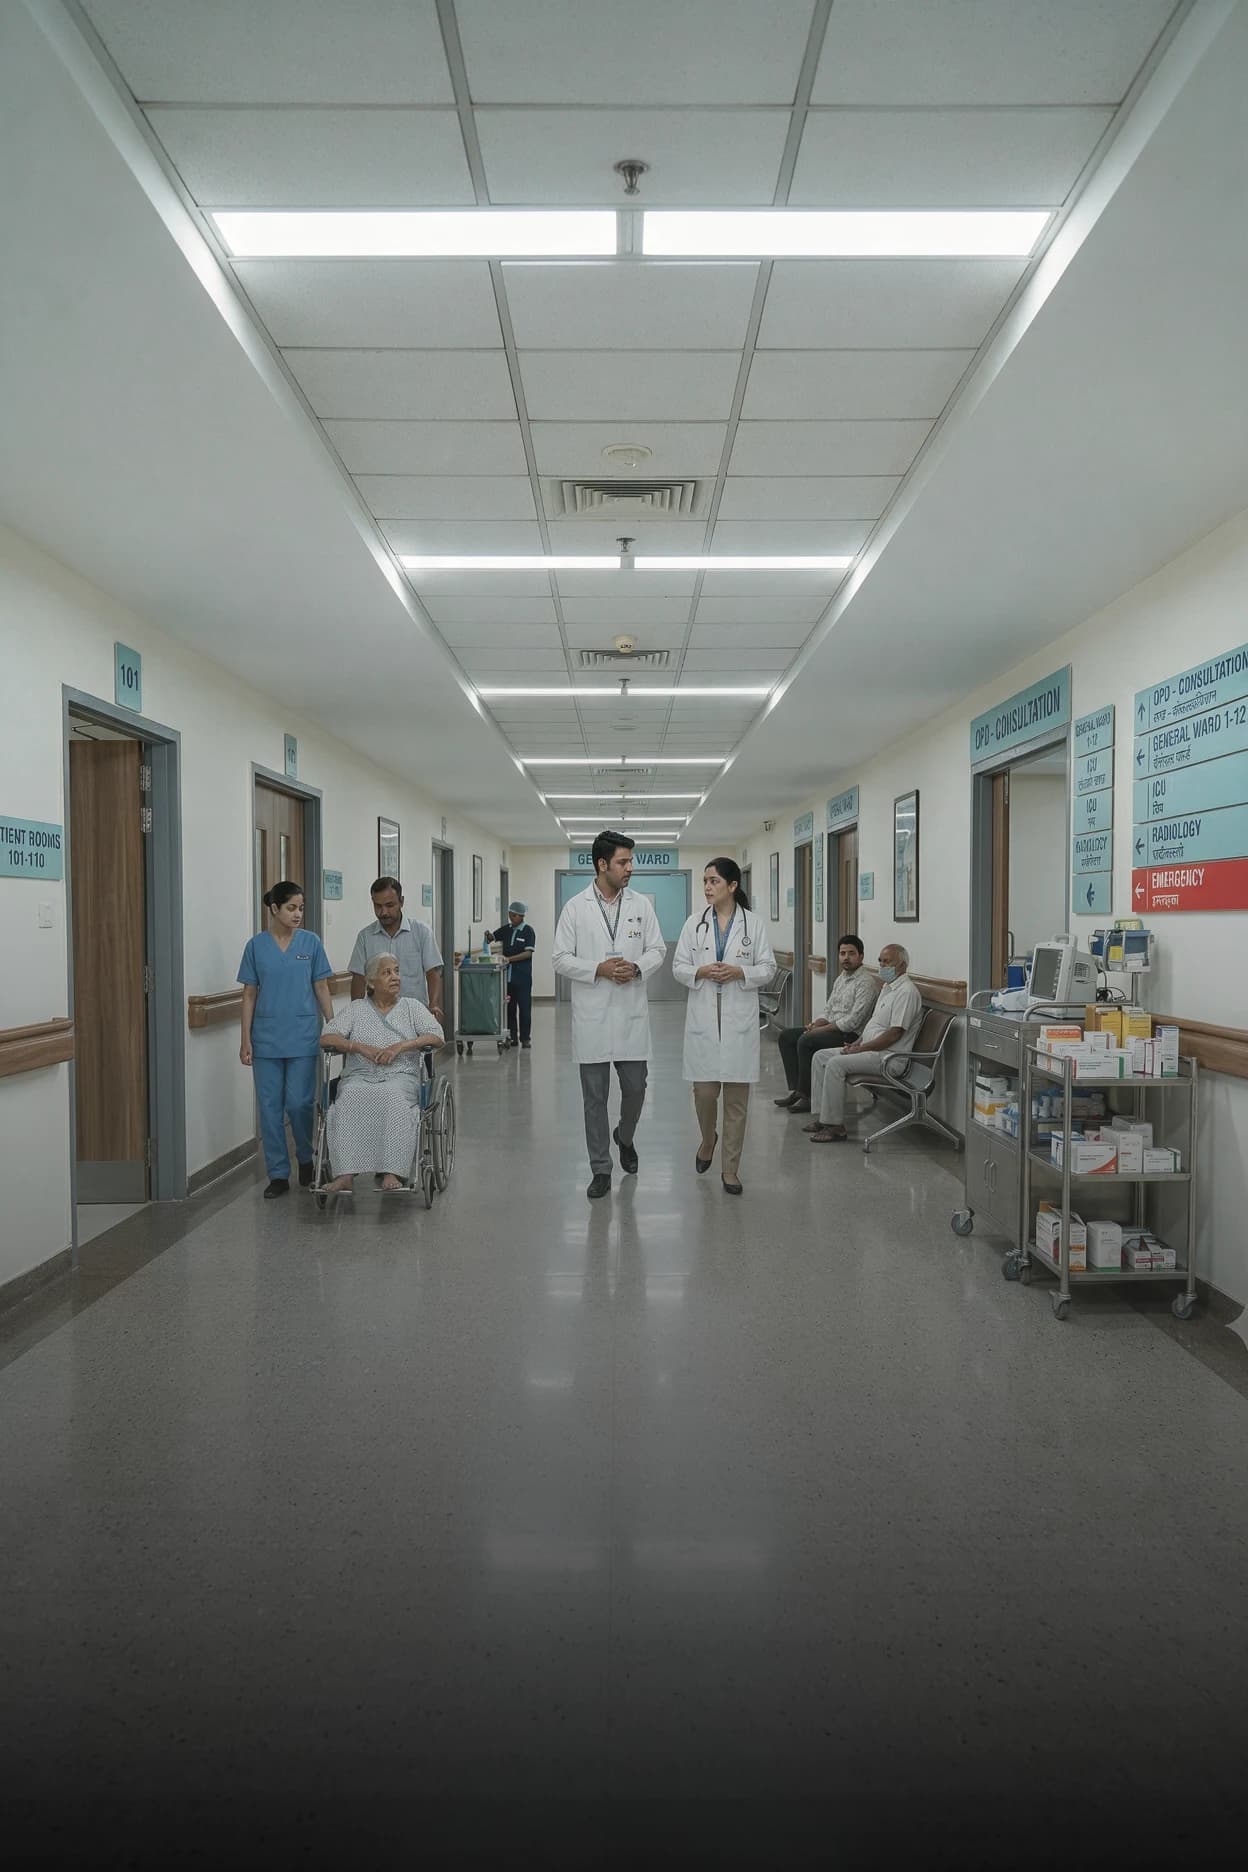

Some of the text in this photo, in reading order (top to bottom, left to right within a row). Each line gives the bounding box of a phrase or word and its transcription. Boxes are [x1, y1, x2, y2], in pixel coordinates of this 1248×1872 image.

[121, 663, 139, 691] 101
[1153, 685, 1170, 706] OPD
[1178, 650, 1248, 696] CONSULTATION
[975, 724, 990, 750] OPD
[995, 685, 1060, 741] CONSULTATION
[1153, 724, 1191, 752] GENERAL
[1192, 714, 1221, 739] WARD
[1224, 705, 1246, 729] 1-12
[1152, 779, 1166, 798] ICU
[1086, 798, 1097, 813] ICU
[29, 830, 61, 849] ROOMS
[1152, 819, 1202, 843] RADIOLOGY
[9, 849, 45, 868] 101-110
[635, 853, 670, 865] WARD
[1152, 867, 1205, 889] EMERGENCY
